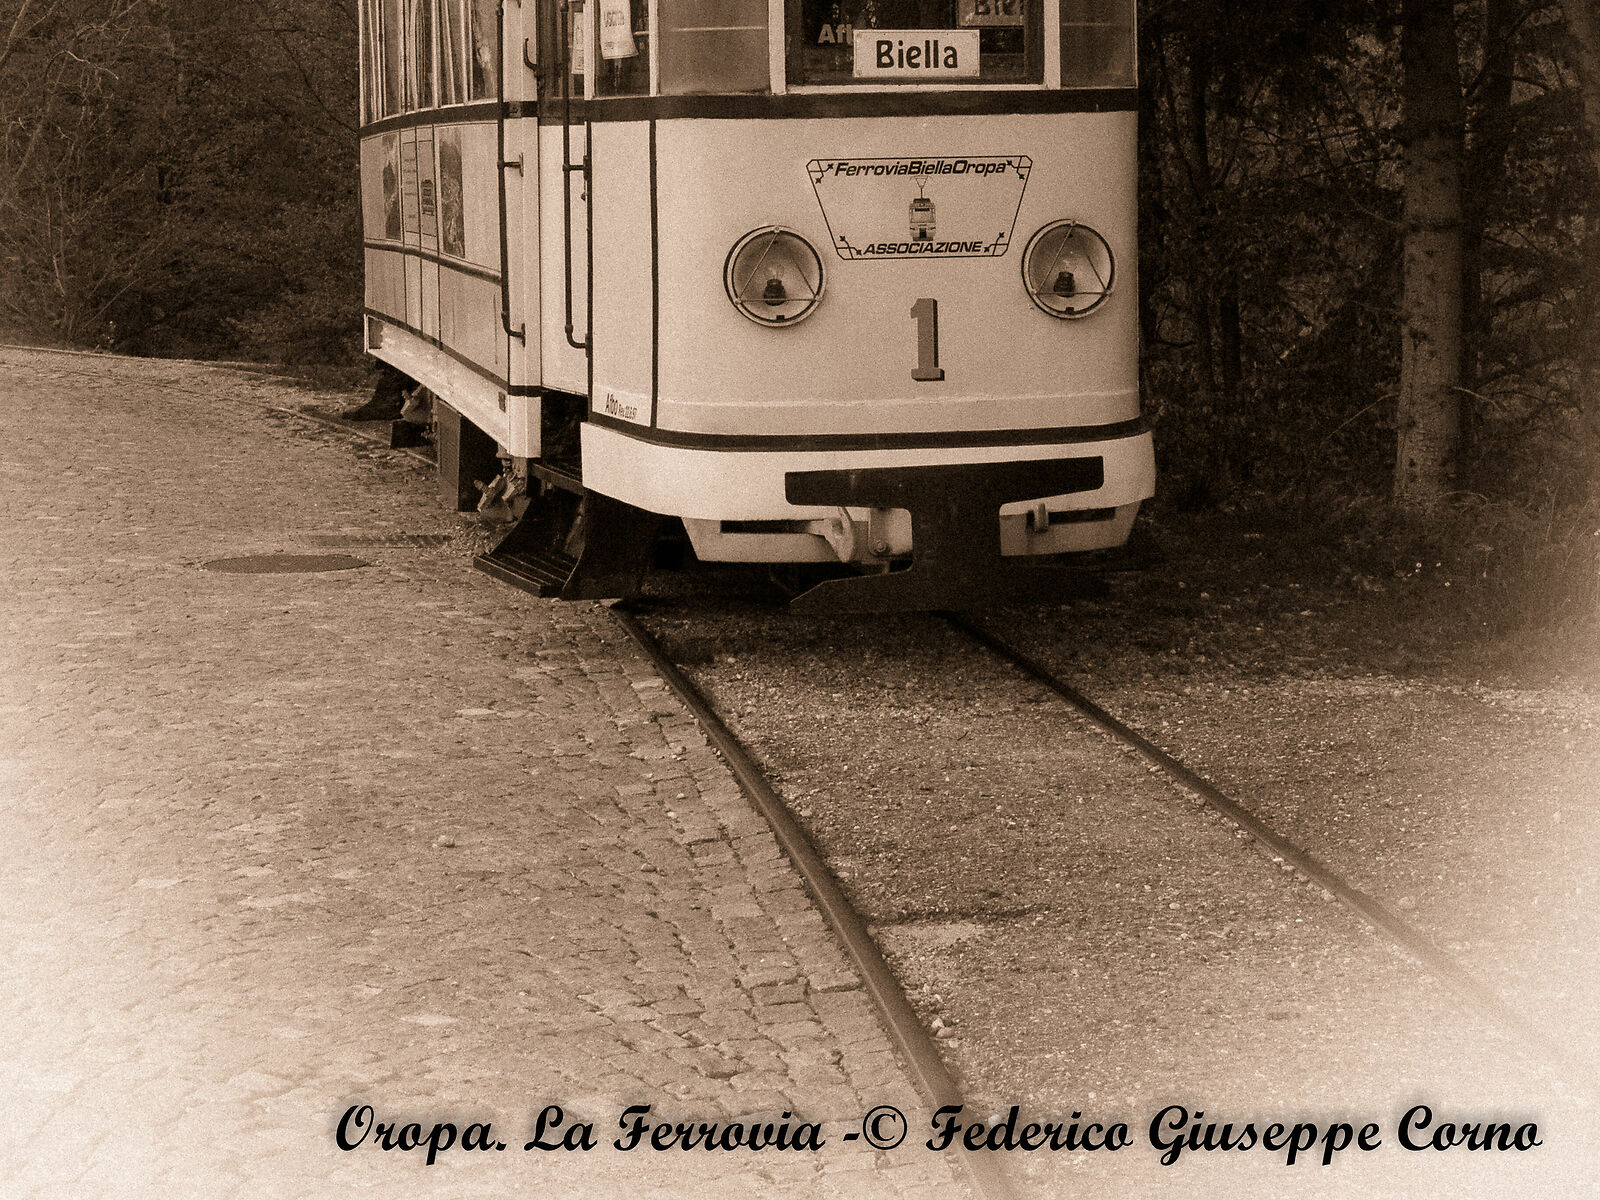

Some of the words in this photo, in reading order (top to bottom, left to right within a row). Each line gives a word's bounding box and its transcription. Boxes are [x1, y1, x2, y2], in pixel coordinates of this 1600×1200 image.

[875, 39, 959, 70] Biella
[833, 159, 1007, 178] FerroviaBiellaOropa
[862, 241, 984, 256] ASSOCIAZIONE
[909, 297, 946, 383] 1
